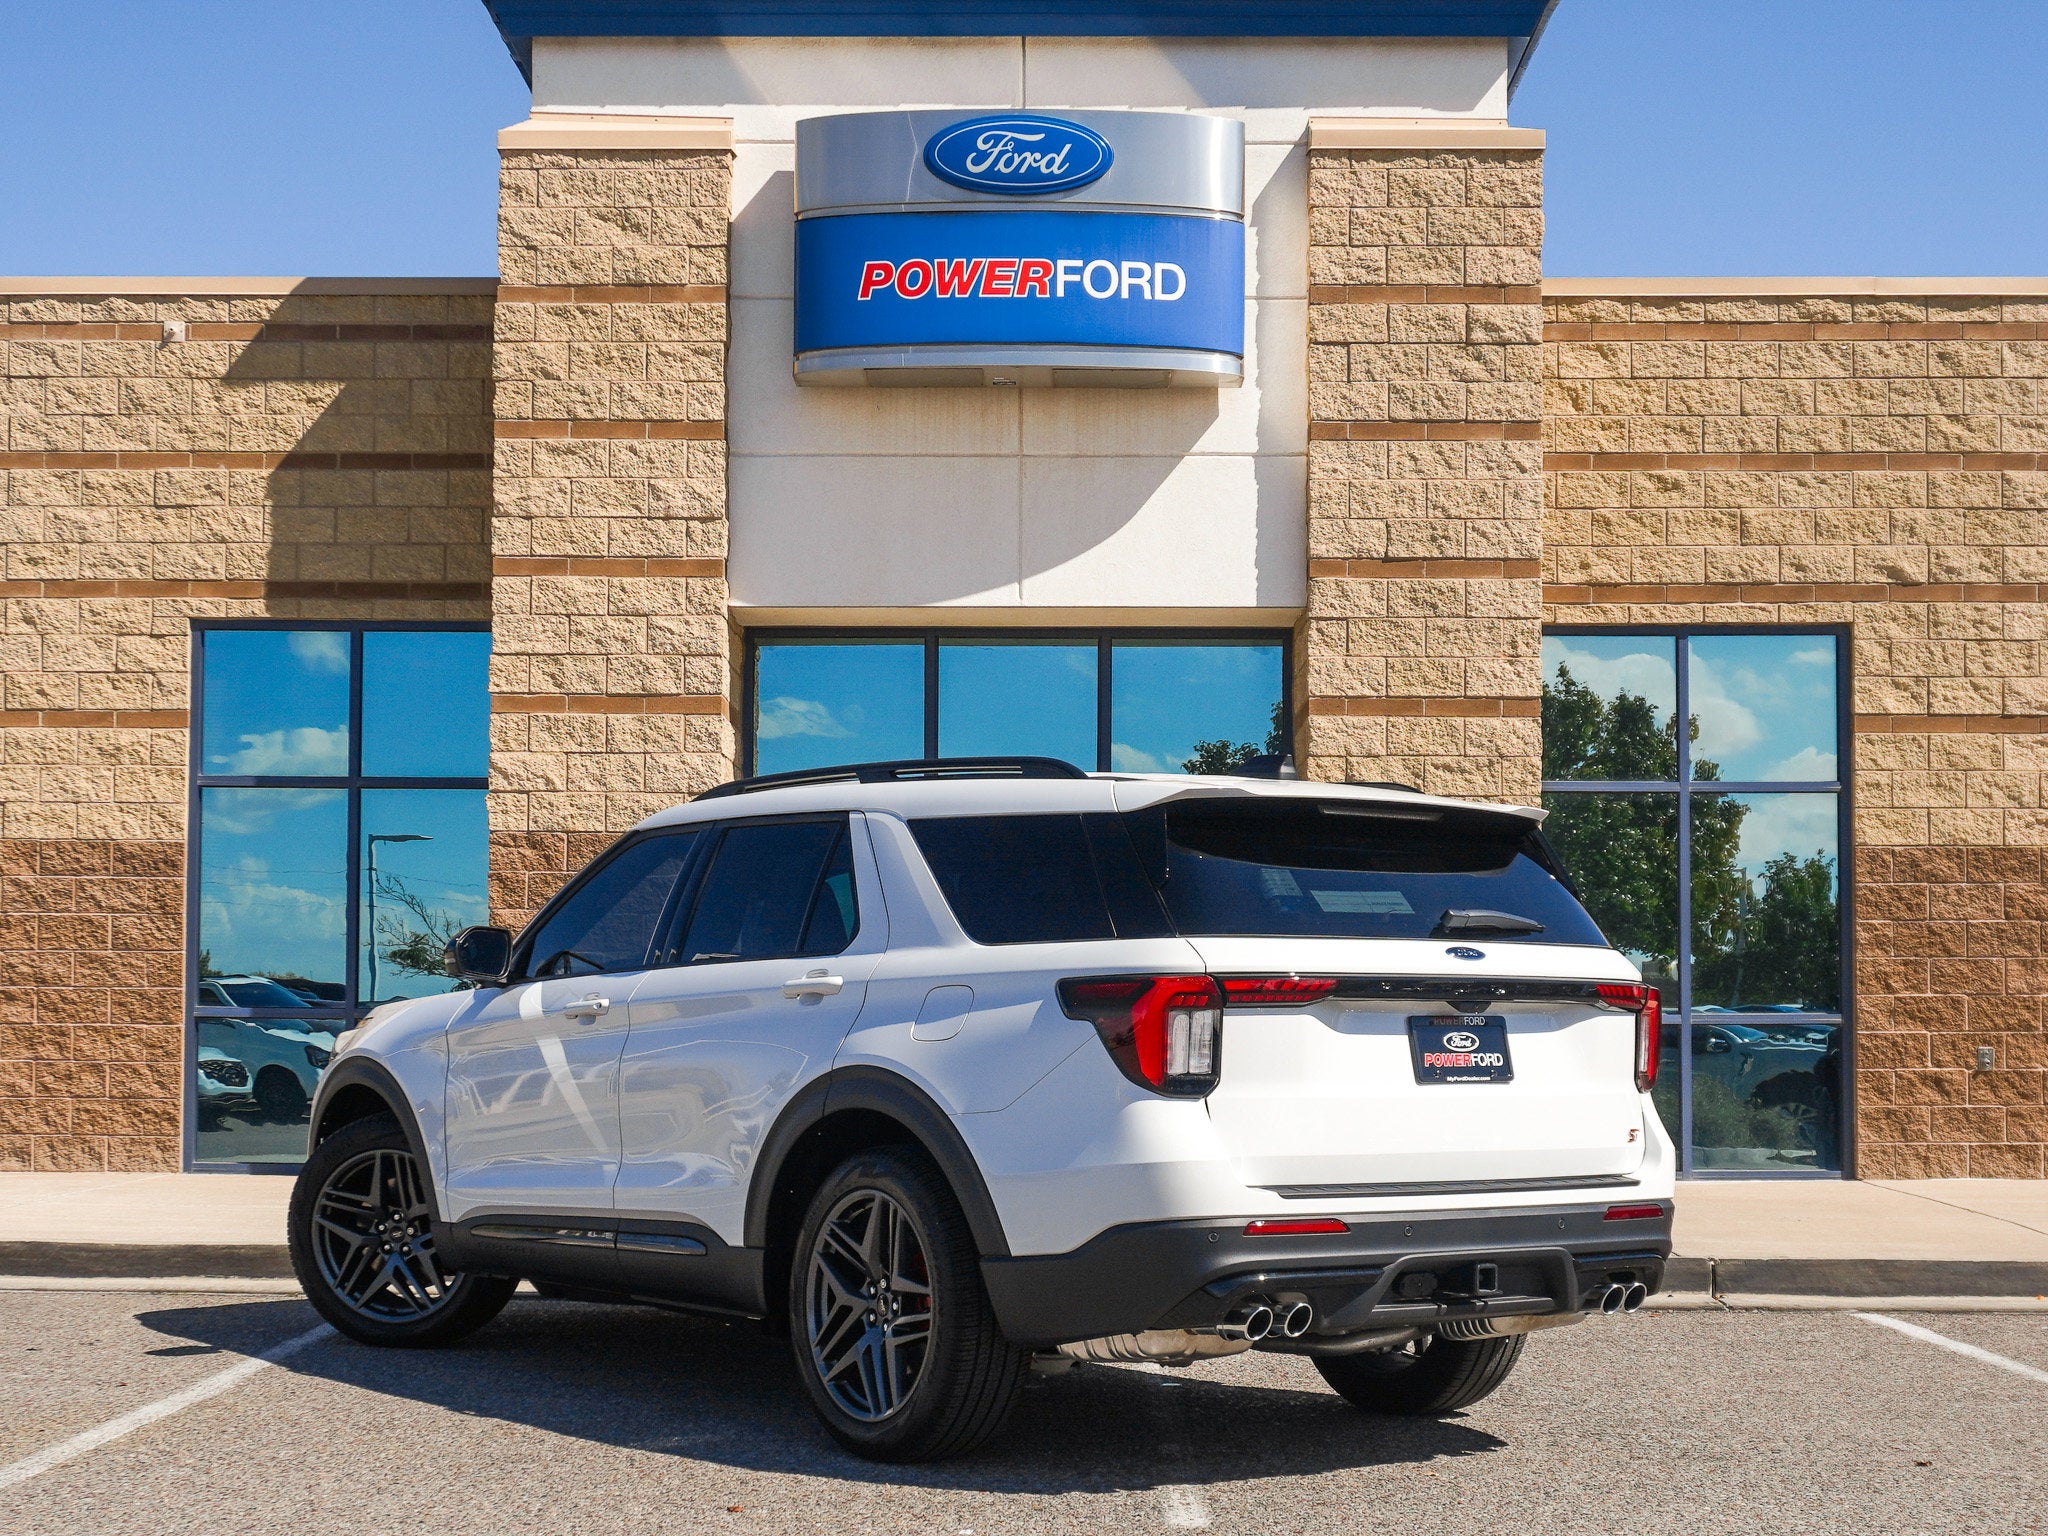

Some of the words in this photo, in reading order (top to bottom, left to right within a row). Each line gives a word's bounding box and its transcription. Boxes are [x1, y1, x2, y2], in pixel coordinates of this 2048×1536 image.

[966, 130, 1072, 175] Ford
[857, 258, 1187, 301] POWERFORD
[1450, 1035, 1472, 1047] Ford
[1425, 1053, 1503, 1067] POWERFORD
